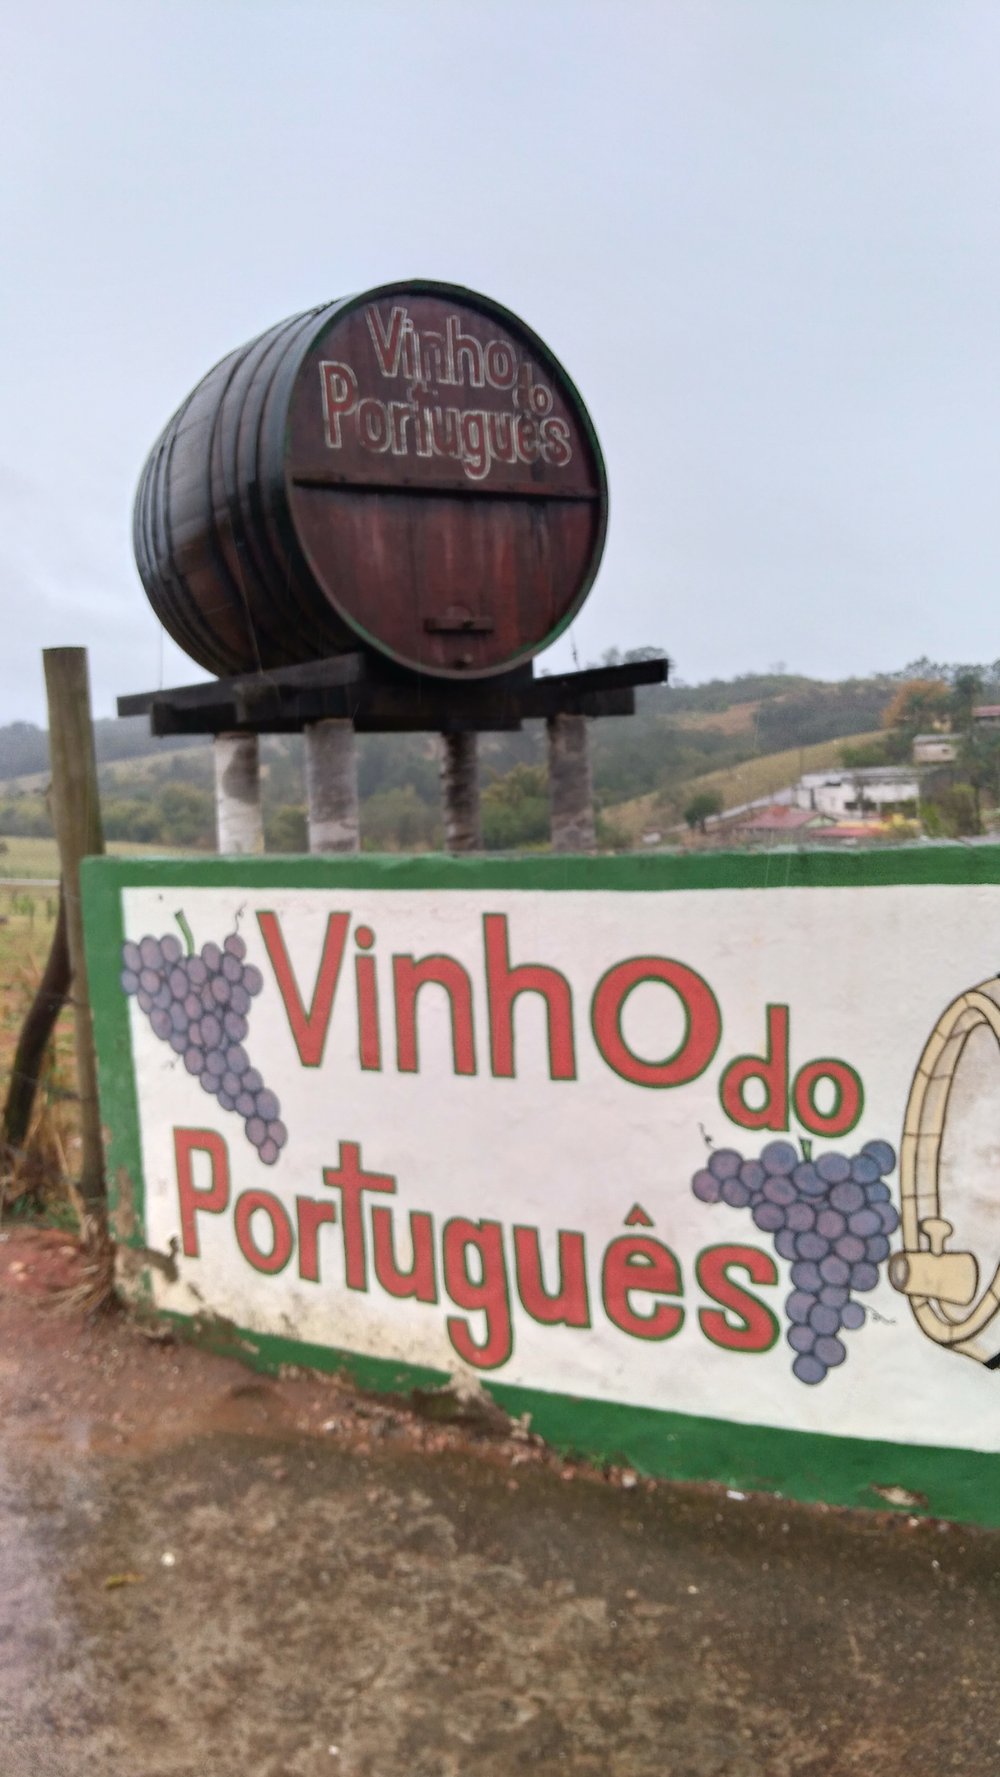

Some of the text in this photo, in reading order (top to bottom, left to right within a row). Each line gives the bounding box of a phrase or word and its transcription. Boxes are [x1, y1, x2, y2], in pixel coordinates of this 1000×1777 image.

[364, 303, 552, 416] Vinho do
[255, 910, 865, 1139] Vinho do
[172, 1126, 781, 1370] Português
